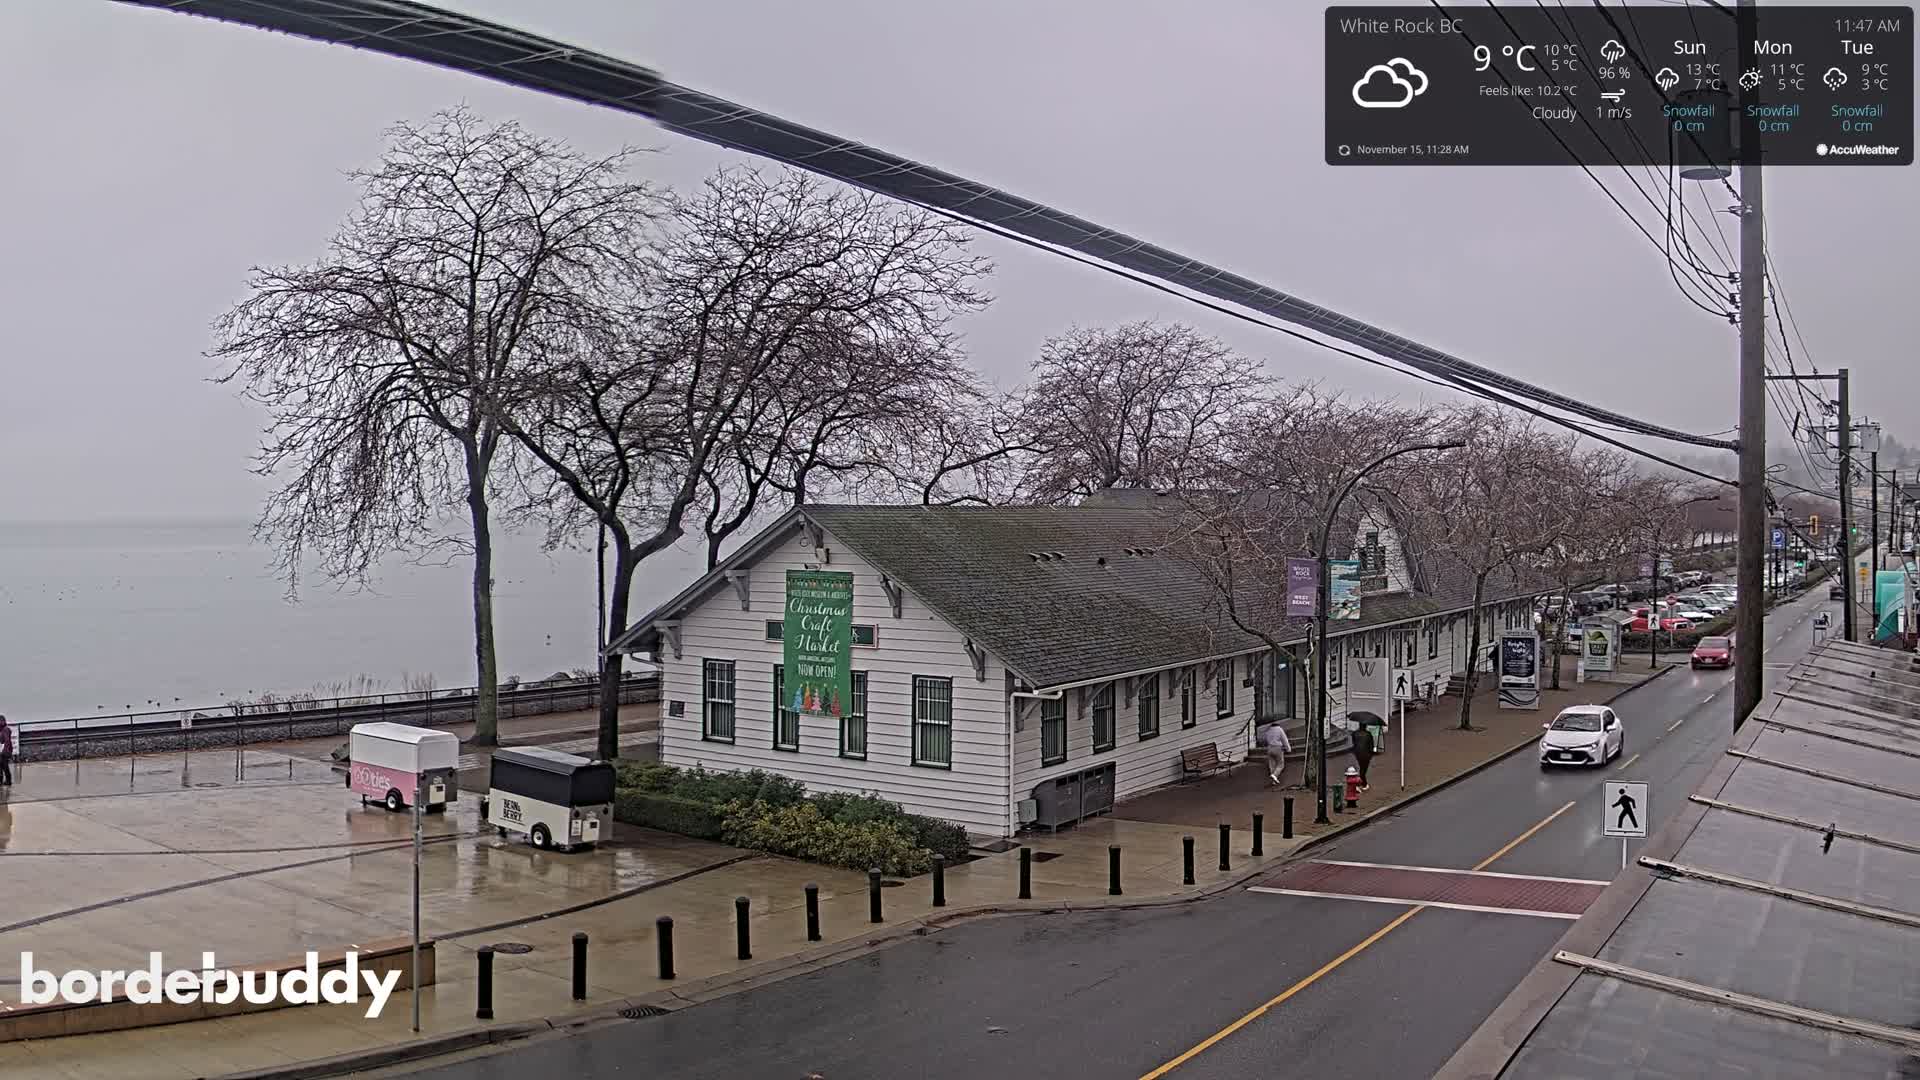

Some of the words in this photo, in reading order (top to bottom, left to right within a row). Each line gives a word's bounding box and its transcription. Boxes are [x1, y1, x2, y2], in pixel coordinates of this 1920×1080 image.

[790, 597, 848, 616] Christmas
[801, 614, 833, 641] Craft
[793, 634, 841, 653] Market
[798, 663, 814, 677] NOW
[815, 665, 837, 679] OPEN!
[1357, 660, 1376, 677] W
[503, 808, 522, 821] BERRY
